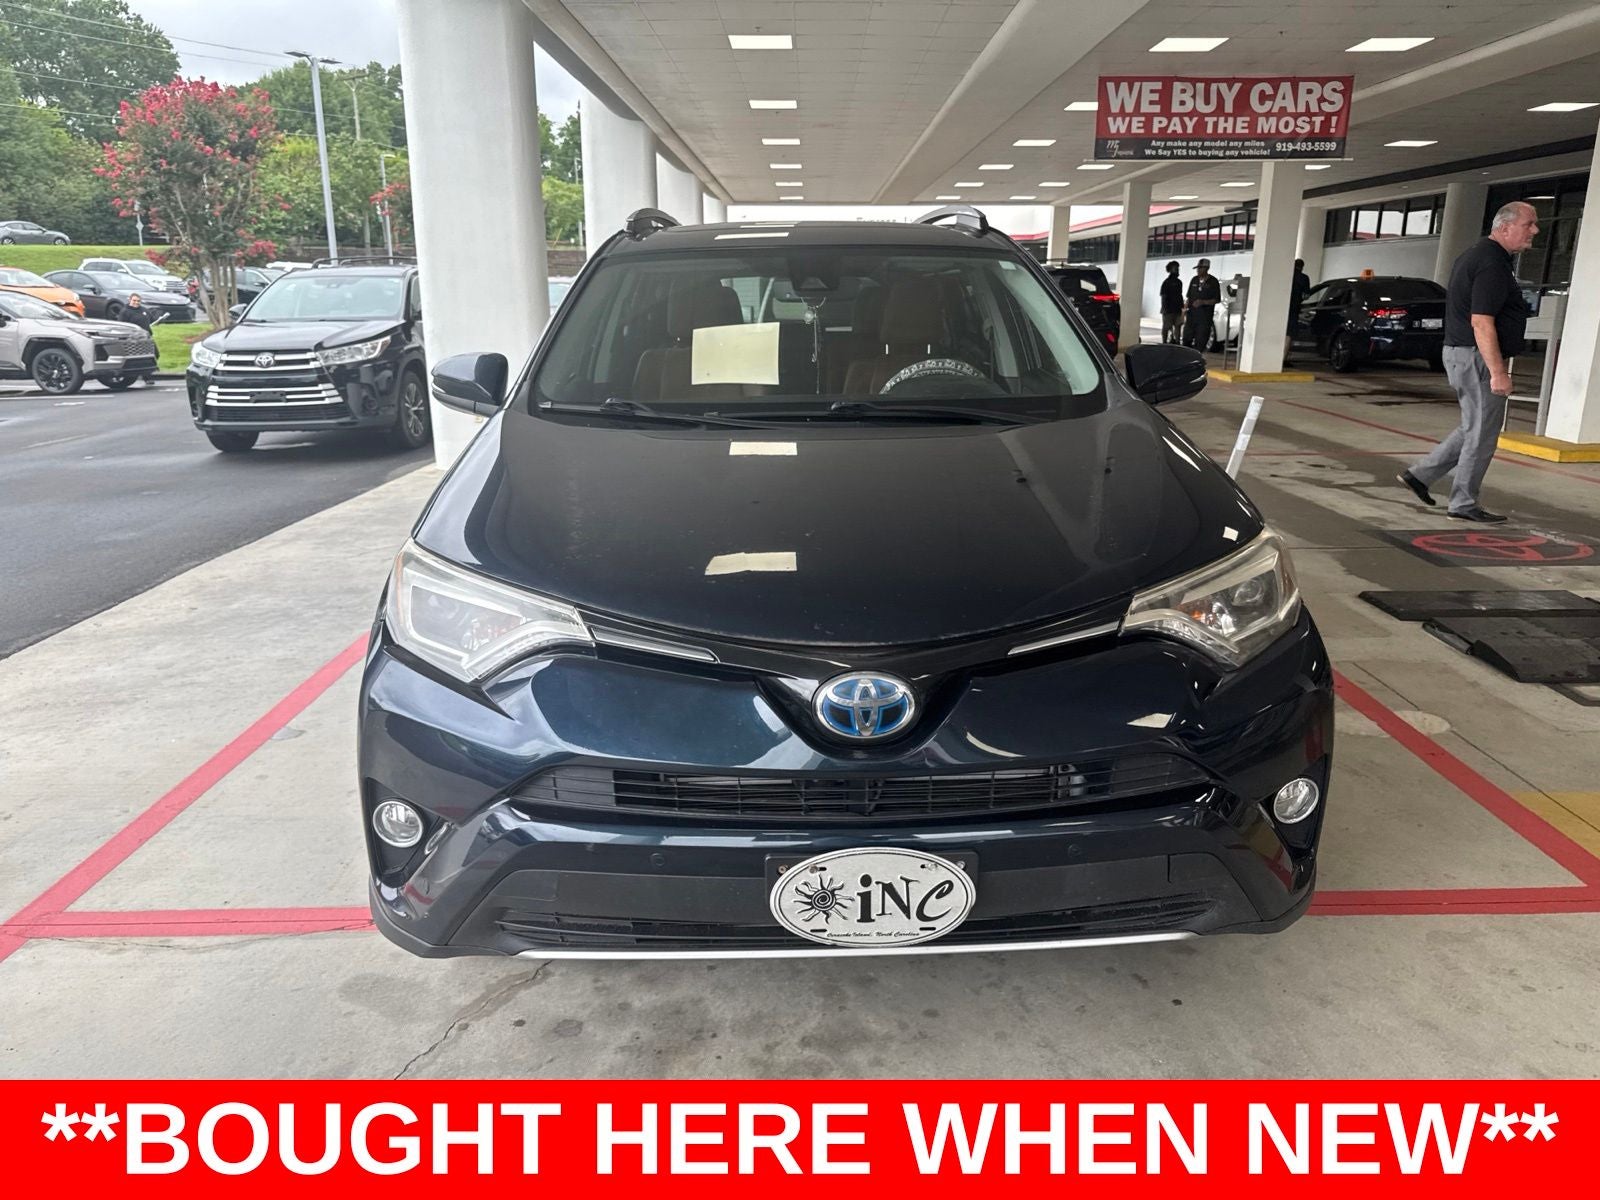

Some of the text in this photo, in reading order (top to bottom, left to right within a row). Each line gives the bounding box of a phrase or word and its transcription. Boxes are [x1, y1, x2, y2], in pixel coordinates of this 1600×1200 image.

[1106, 81, 1345, 113] WE BUY CARS
[1107, 117, 1145, 134] WE
[1152, 116, 1200, 134] PAY
[1205, 116, 1249, 134] THE
[1257, 116, 1325, 134] MOST
[1158, 149, 1171, 157] Say
[1198, 149, 1224, 157] buying
[1275, 141, 1337, 152] 919-493-5599
